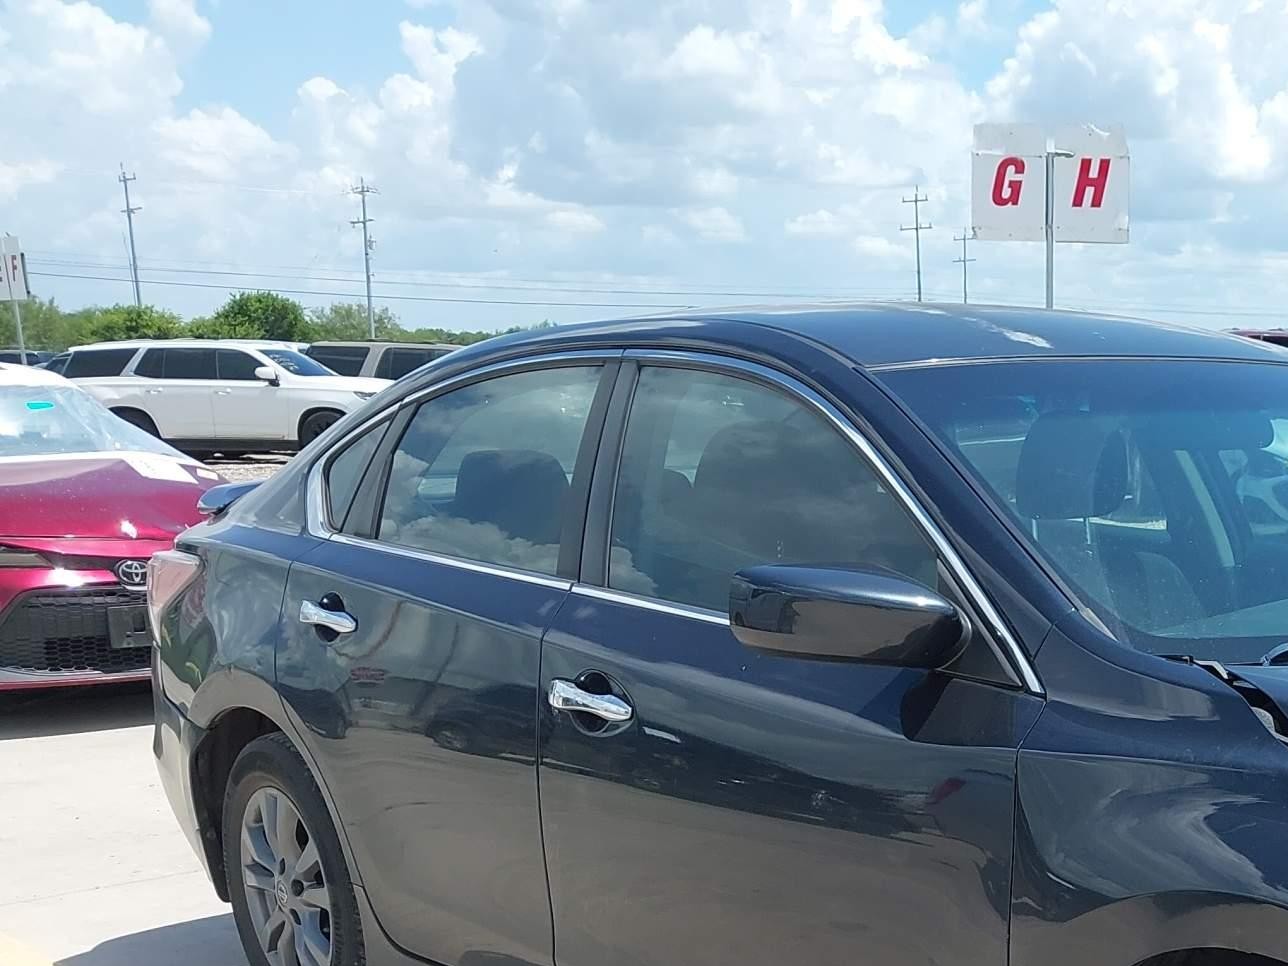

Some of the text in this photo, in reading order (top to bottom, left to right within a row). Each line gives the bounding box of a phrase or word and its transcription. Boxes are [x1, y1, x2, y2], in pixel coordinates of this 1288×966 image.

[991, 156, 1026, 207] G
[1072, 158, 1111, 208] H
[11, 254, 17, 282] F
